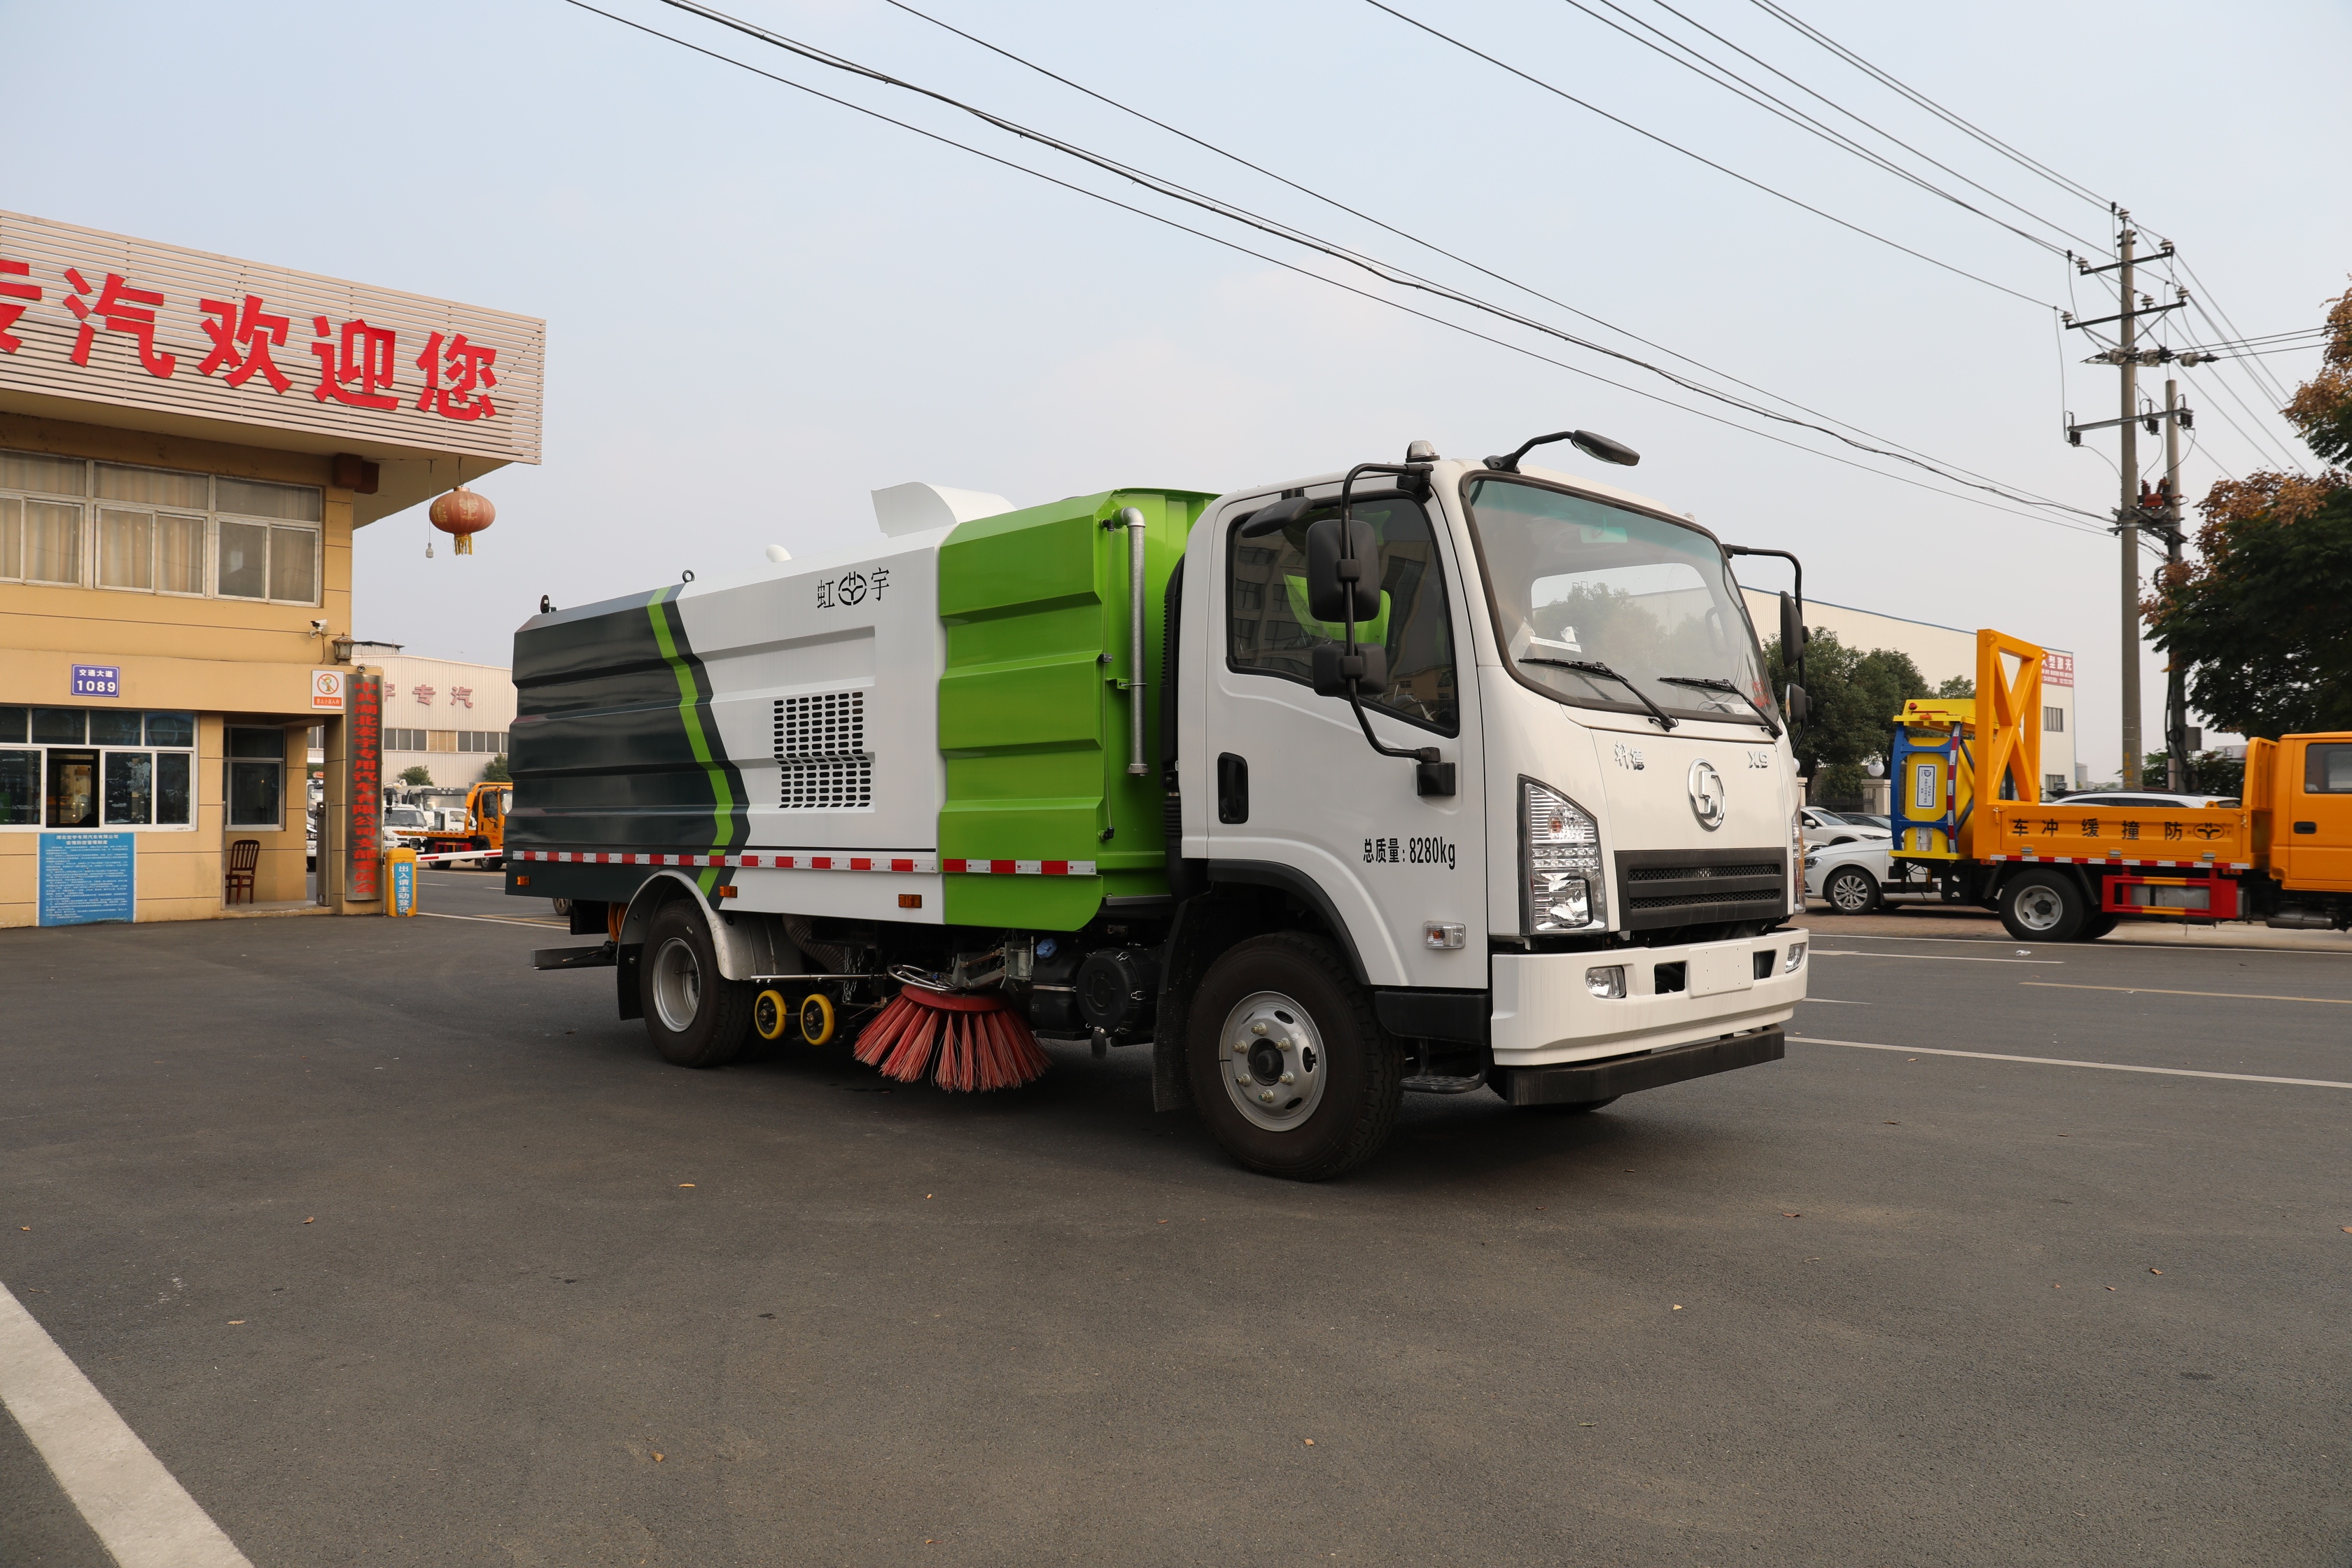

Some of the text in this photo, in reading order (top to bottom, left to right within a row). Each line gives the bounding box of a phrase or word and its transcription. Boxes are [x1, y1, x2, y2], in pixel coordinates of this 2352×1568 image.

[817, 579, 835, 609] 虹
[870, 566, 890, 601] 宇
[77, 680, 116, 692] 1089
[78, 668, 113, 678] 交通大道
[353, 682, 378, 893] 中共湖北宏宇专用汽车有限公司支部委员会
[398, 865, 410, 913] 出入请主动登记
